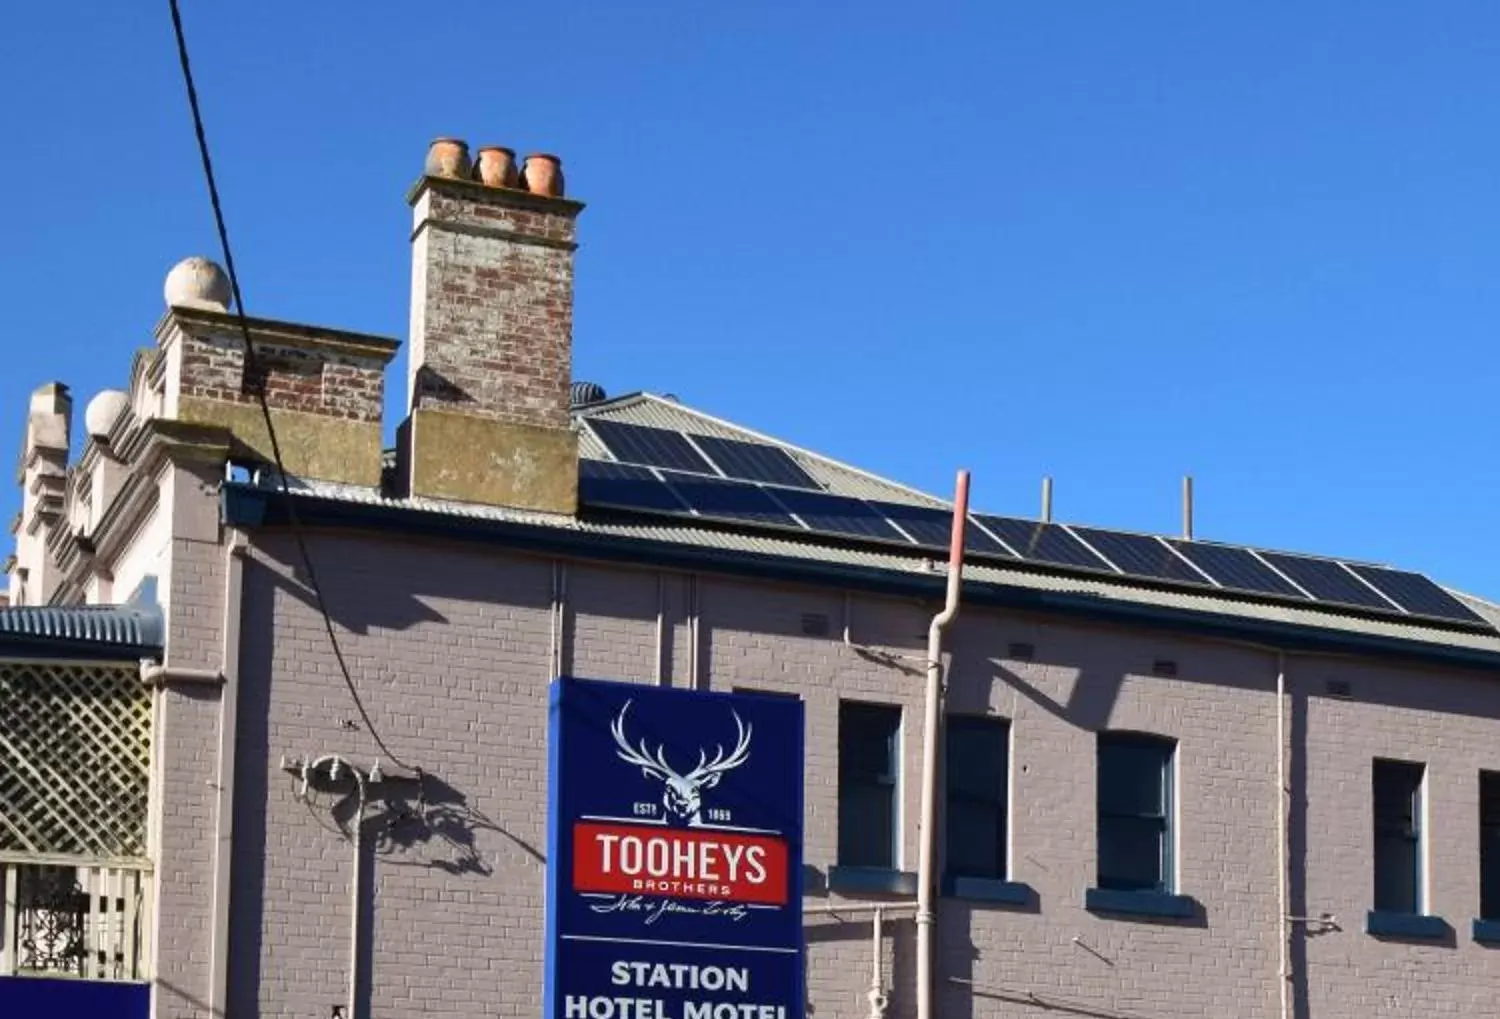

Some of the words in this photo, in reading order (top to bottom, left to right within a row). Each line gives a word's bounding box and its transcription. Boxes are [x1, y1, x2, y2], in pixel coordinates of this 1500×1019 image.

[596, 834, 767, 883] TOOHEYS
[633, 880, 731, 897] BROTHERS
[611, 961, 749, 991] STATION
